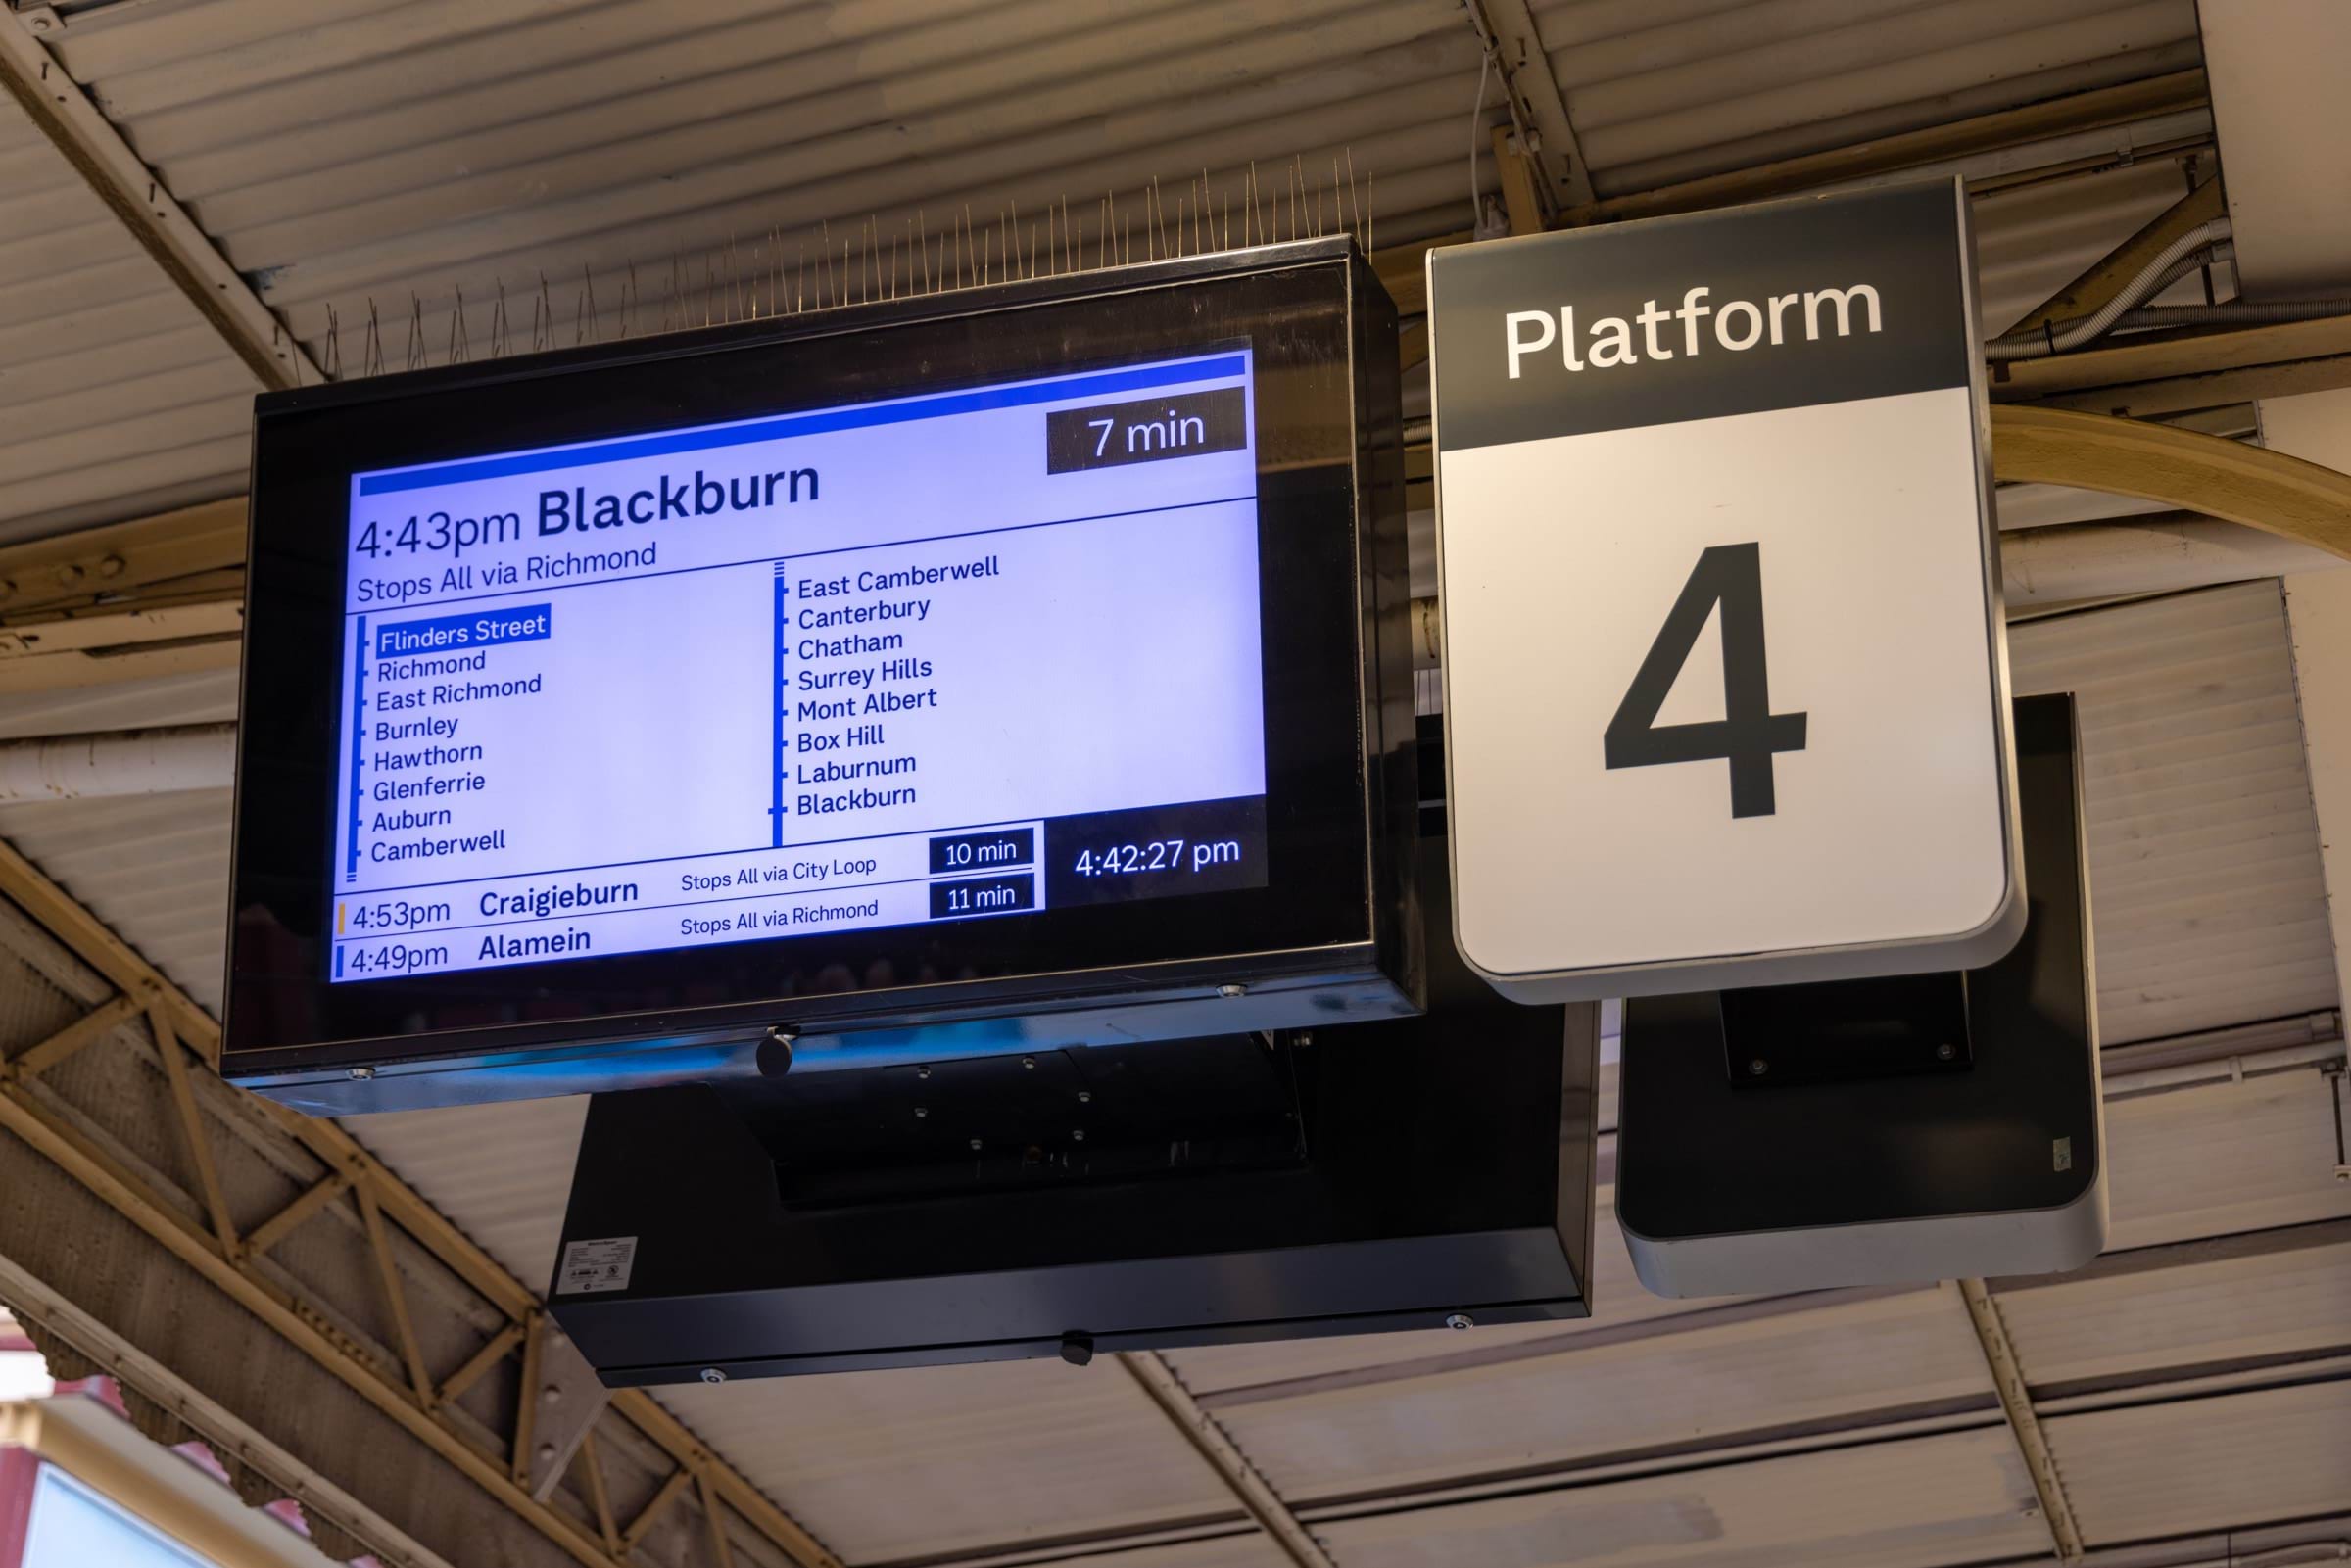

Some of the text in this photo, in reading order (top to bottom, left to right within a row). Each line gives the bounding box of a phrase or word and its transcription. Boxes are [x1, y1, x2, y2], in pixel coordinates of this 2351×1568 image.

[1507, 285, 1881, 379] Platform
[1089, 410, 1203, 456] 7 min
[356, 468, 818, 559] 4:43pm Blackburn
[358, 542, 656, 603] Stops All via Richmond
[799, 556, 999, 599] East Camberwell
[799, 599, 930, 629] Canterbury
[382, 615, 545, 652] Flinders Street
[799, 635, 903, 660] Chatham
[378, 650, 486, 682] Richmond
[799, 658, 932, 690] Surrey Hills
[1604, 542, 1807, 819] 4
[377, 674, 541, 711] East Richmond
[799, 689, 936, 721] Mont Albert
[376, 717, 458, 741] Burnley
[798, 725, 884, 752] Box Hill
[375, 746, 482, 772] Hawthorn
[798, 757, 915, 784] Laburnum
[374, 772, 485, 801] Glenferrie
[798, 788, 915, 815] Blackburn
[372, 810, 451, 832] Auburn
[371, 829, 505, 862] Camberwell
[1076, 840, 1238, 876] 4:42:27 pm
[353, 840, 1016, 929] 4:53pm Craigieburn Stops All via City Loop 10 min
[351, 885, 1015, 974] 4:49pm Alamein Stops All via Richmond 11 min
